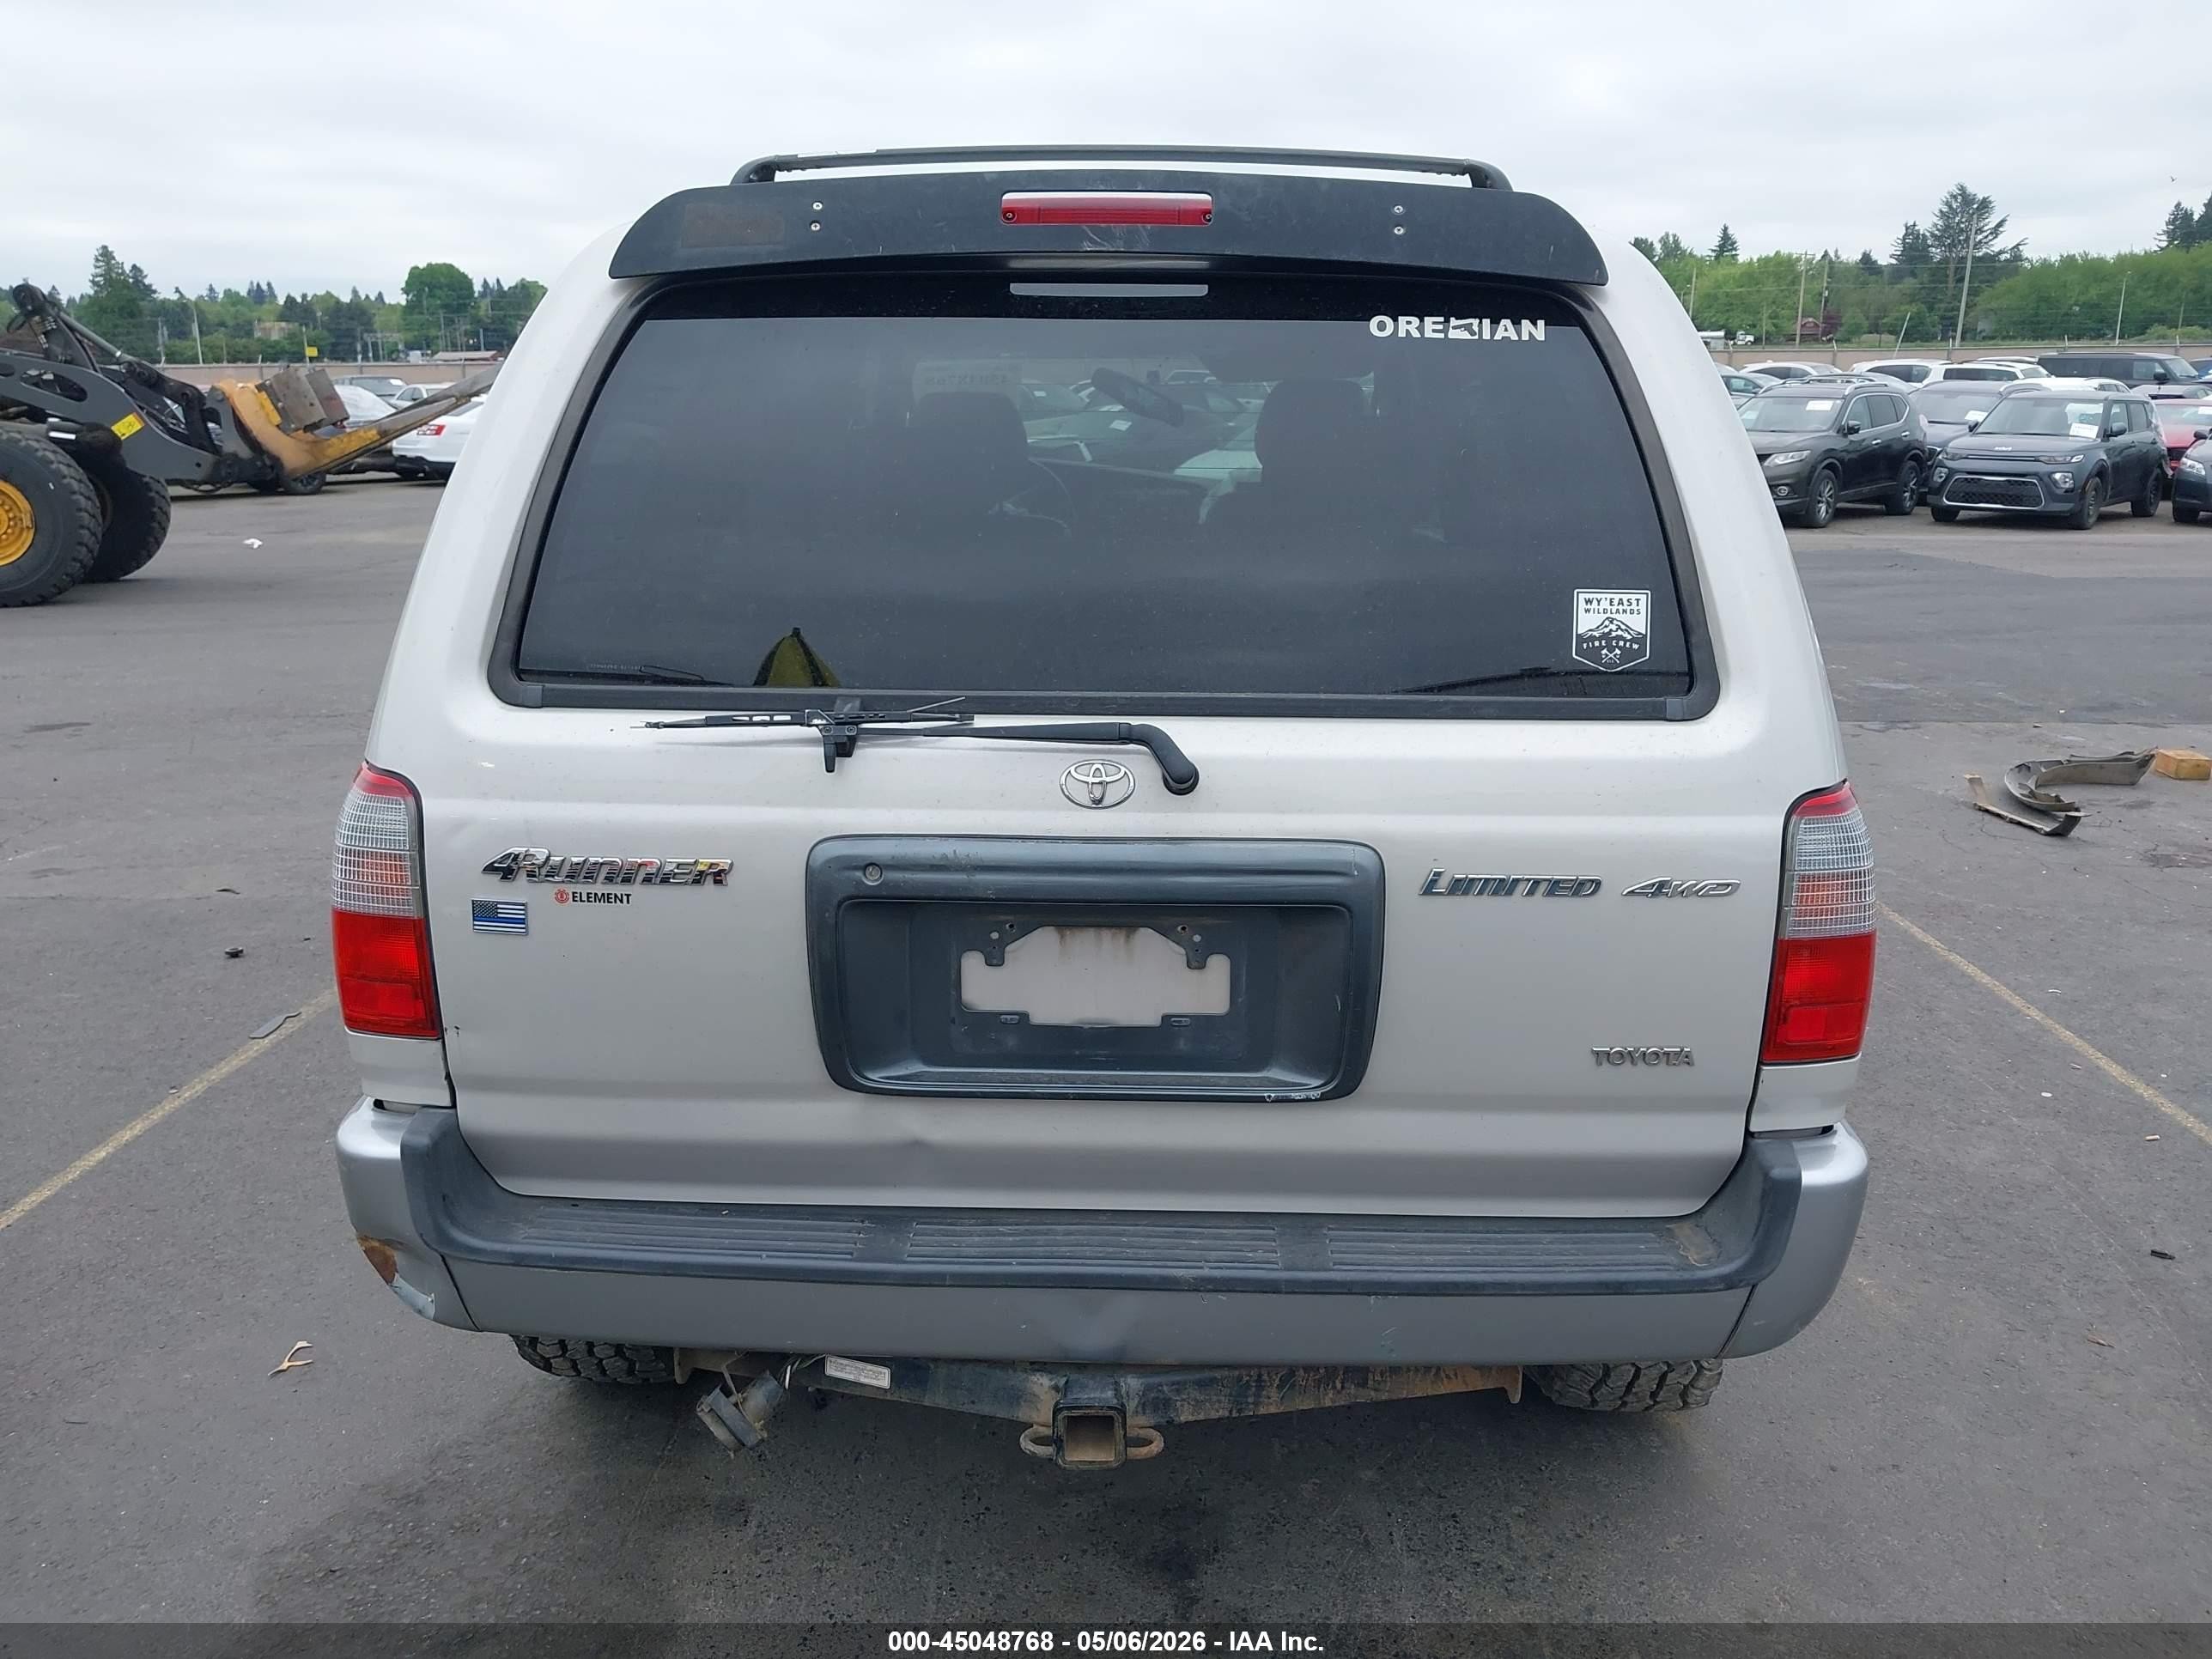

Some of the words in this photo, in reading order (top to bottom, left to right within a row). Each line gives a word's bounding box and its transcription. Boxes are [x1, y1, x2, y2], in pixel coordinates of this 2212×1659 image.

[1583, 597, 1642, 607] WY'EAST
[1583, 607, 1642, 616] WILDLANDS
[1583, 640, 1607, 650] FIRE
[1612, 640, 1640, 650] CREW
[1621, 877, 1742, 899] 4WD
[571, 890, 632, 904] ELEMENT
[1591, 1046, 1695, 1066] TOYOTA
